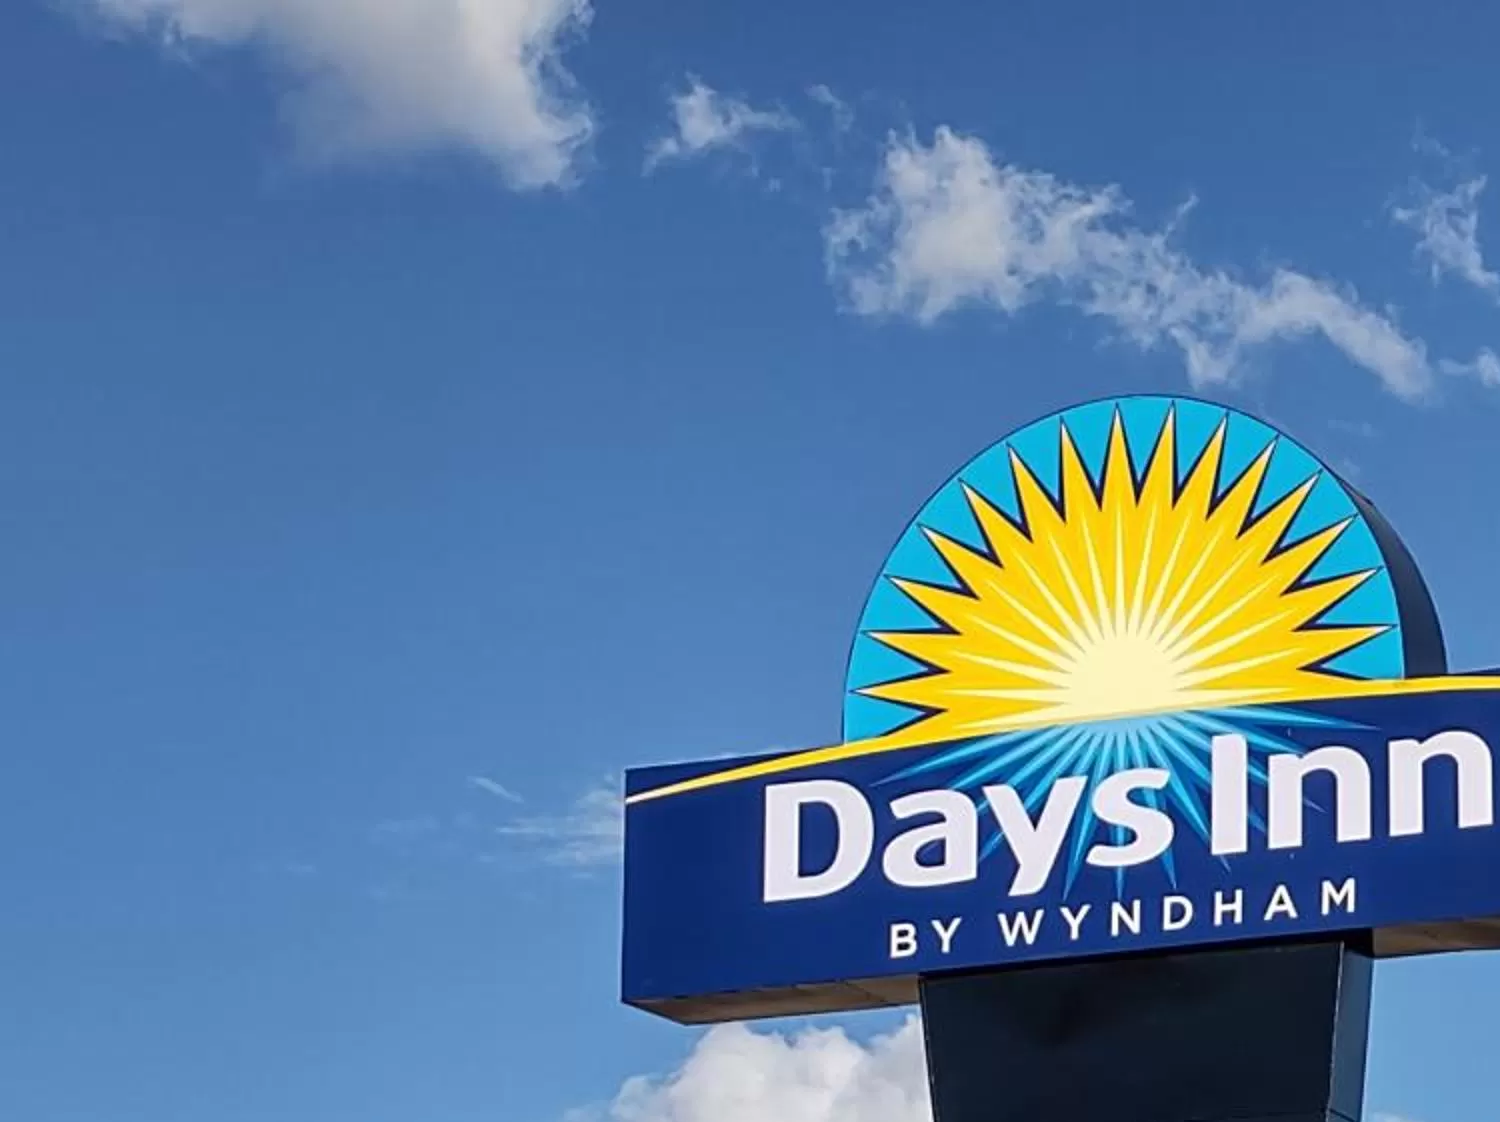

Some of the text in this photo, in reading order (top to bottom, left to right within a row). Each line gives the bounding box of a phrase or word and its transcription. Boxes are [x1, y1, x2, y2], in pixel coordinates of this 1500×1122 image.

[763, 730, 1494, 903] Days Inn
[889, 878, 1356, 959] BY WYNDHAM
